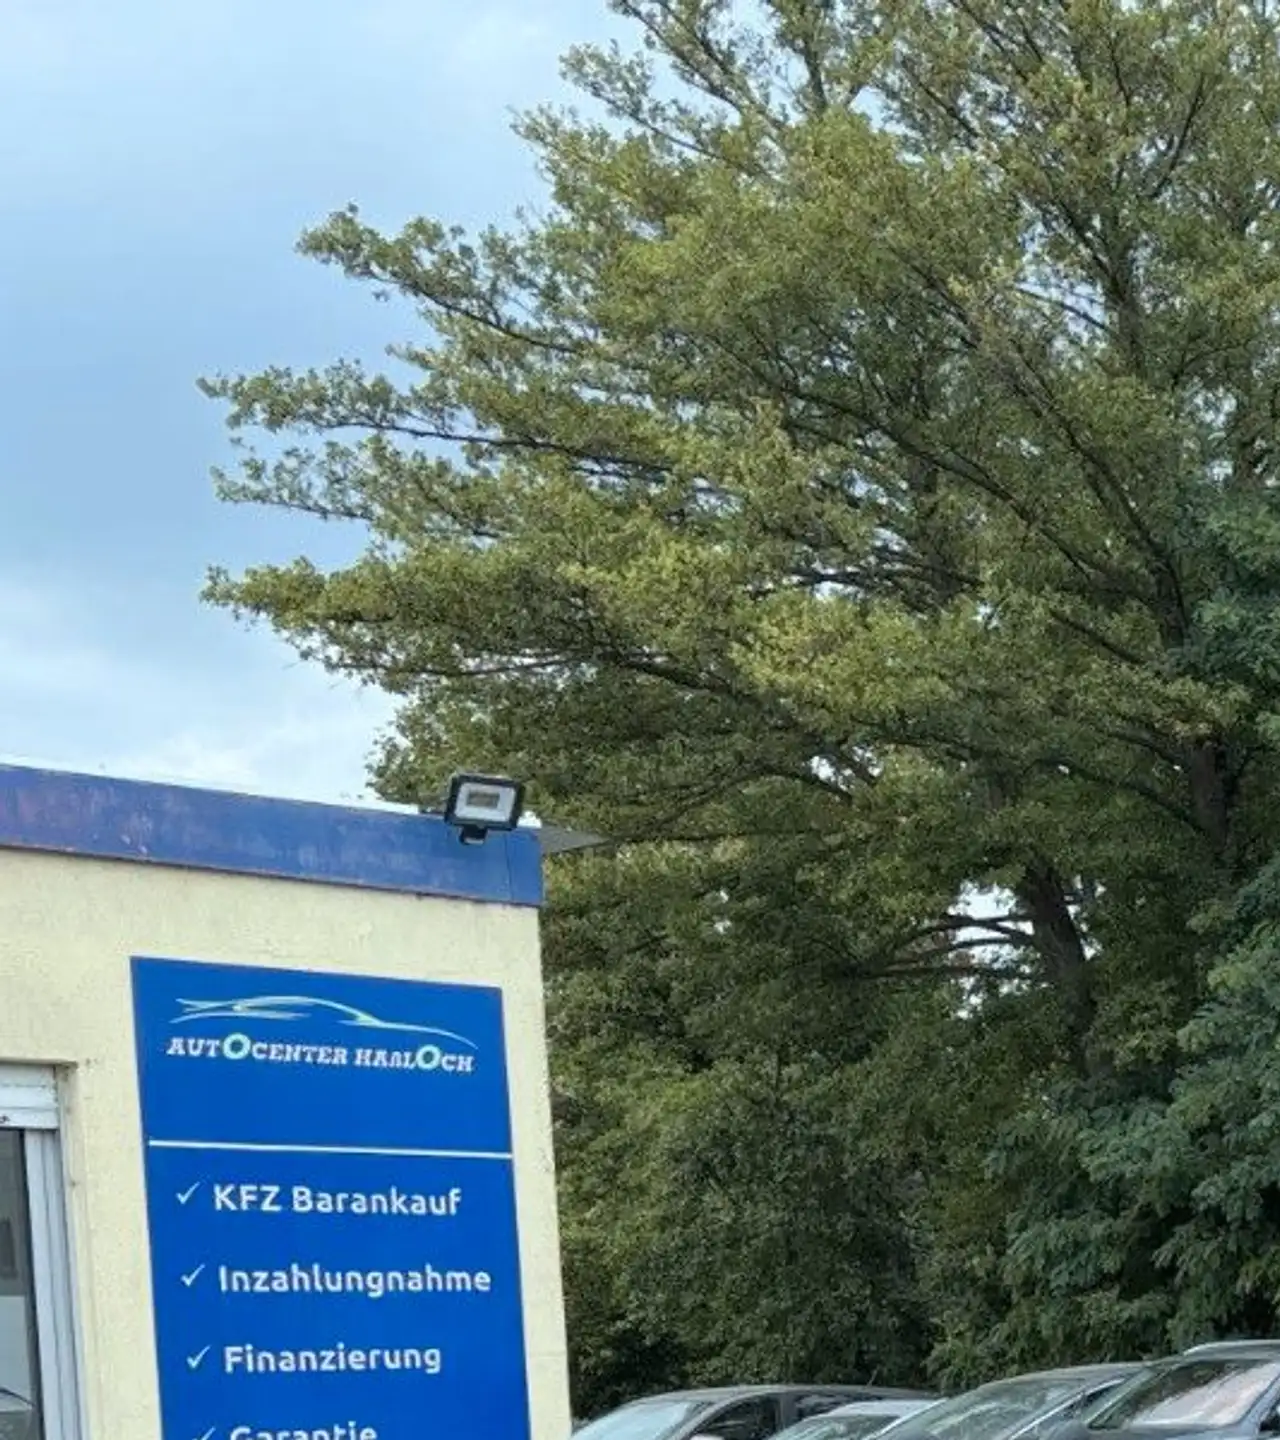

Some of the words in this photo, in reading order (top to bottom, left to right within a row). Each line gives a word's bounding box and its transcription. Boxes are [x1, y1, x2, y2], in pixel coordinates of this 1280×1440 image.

[213, 1184, 282, 1212] KFZ
[292, 1185, 463, 1216] Barankauf
[218, 1262, 493, 1298] Inzahlungnahme
[224, 1343, 442, 1374] Finanzierung
